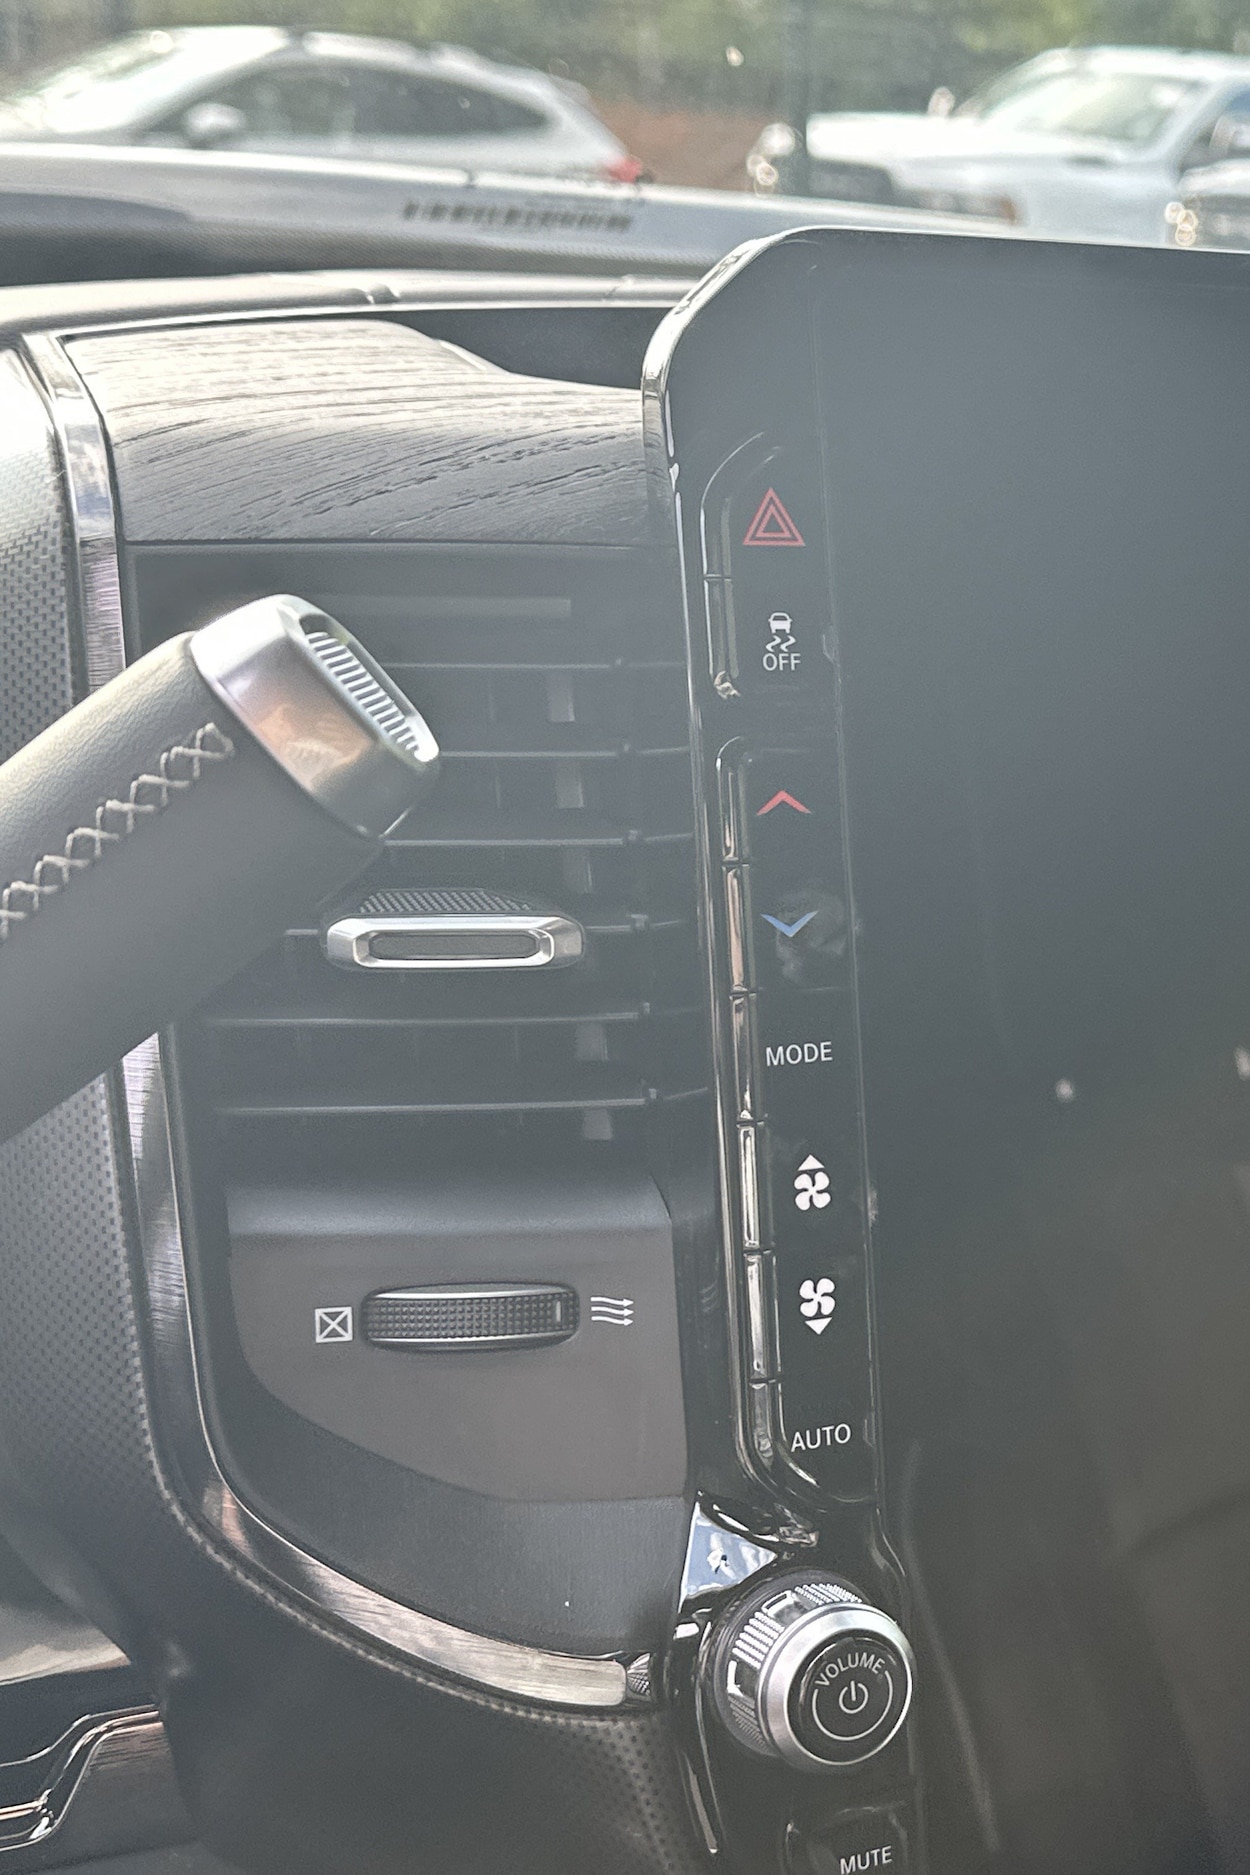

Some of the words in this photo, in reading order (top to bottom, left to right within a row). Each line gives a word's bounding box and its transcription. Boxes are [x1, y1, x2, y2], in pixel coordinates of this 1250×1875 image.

[762, 652, 801, 671] OFF
[765, 1041, 833, 1066] MODE
[790, 1423, 851, 1452] AUTO
[815, 1652, 886, 1688] VOLUME
[839, 1846, 893, 1875] MUTE
